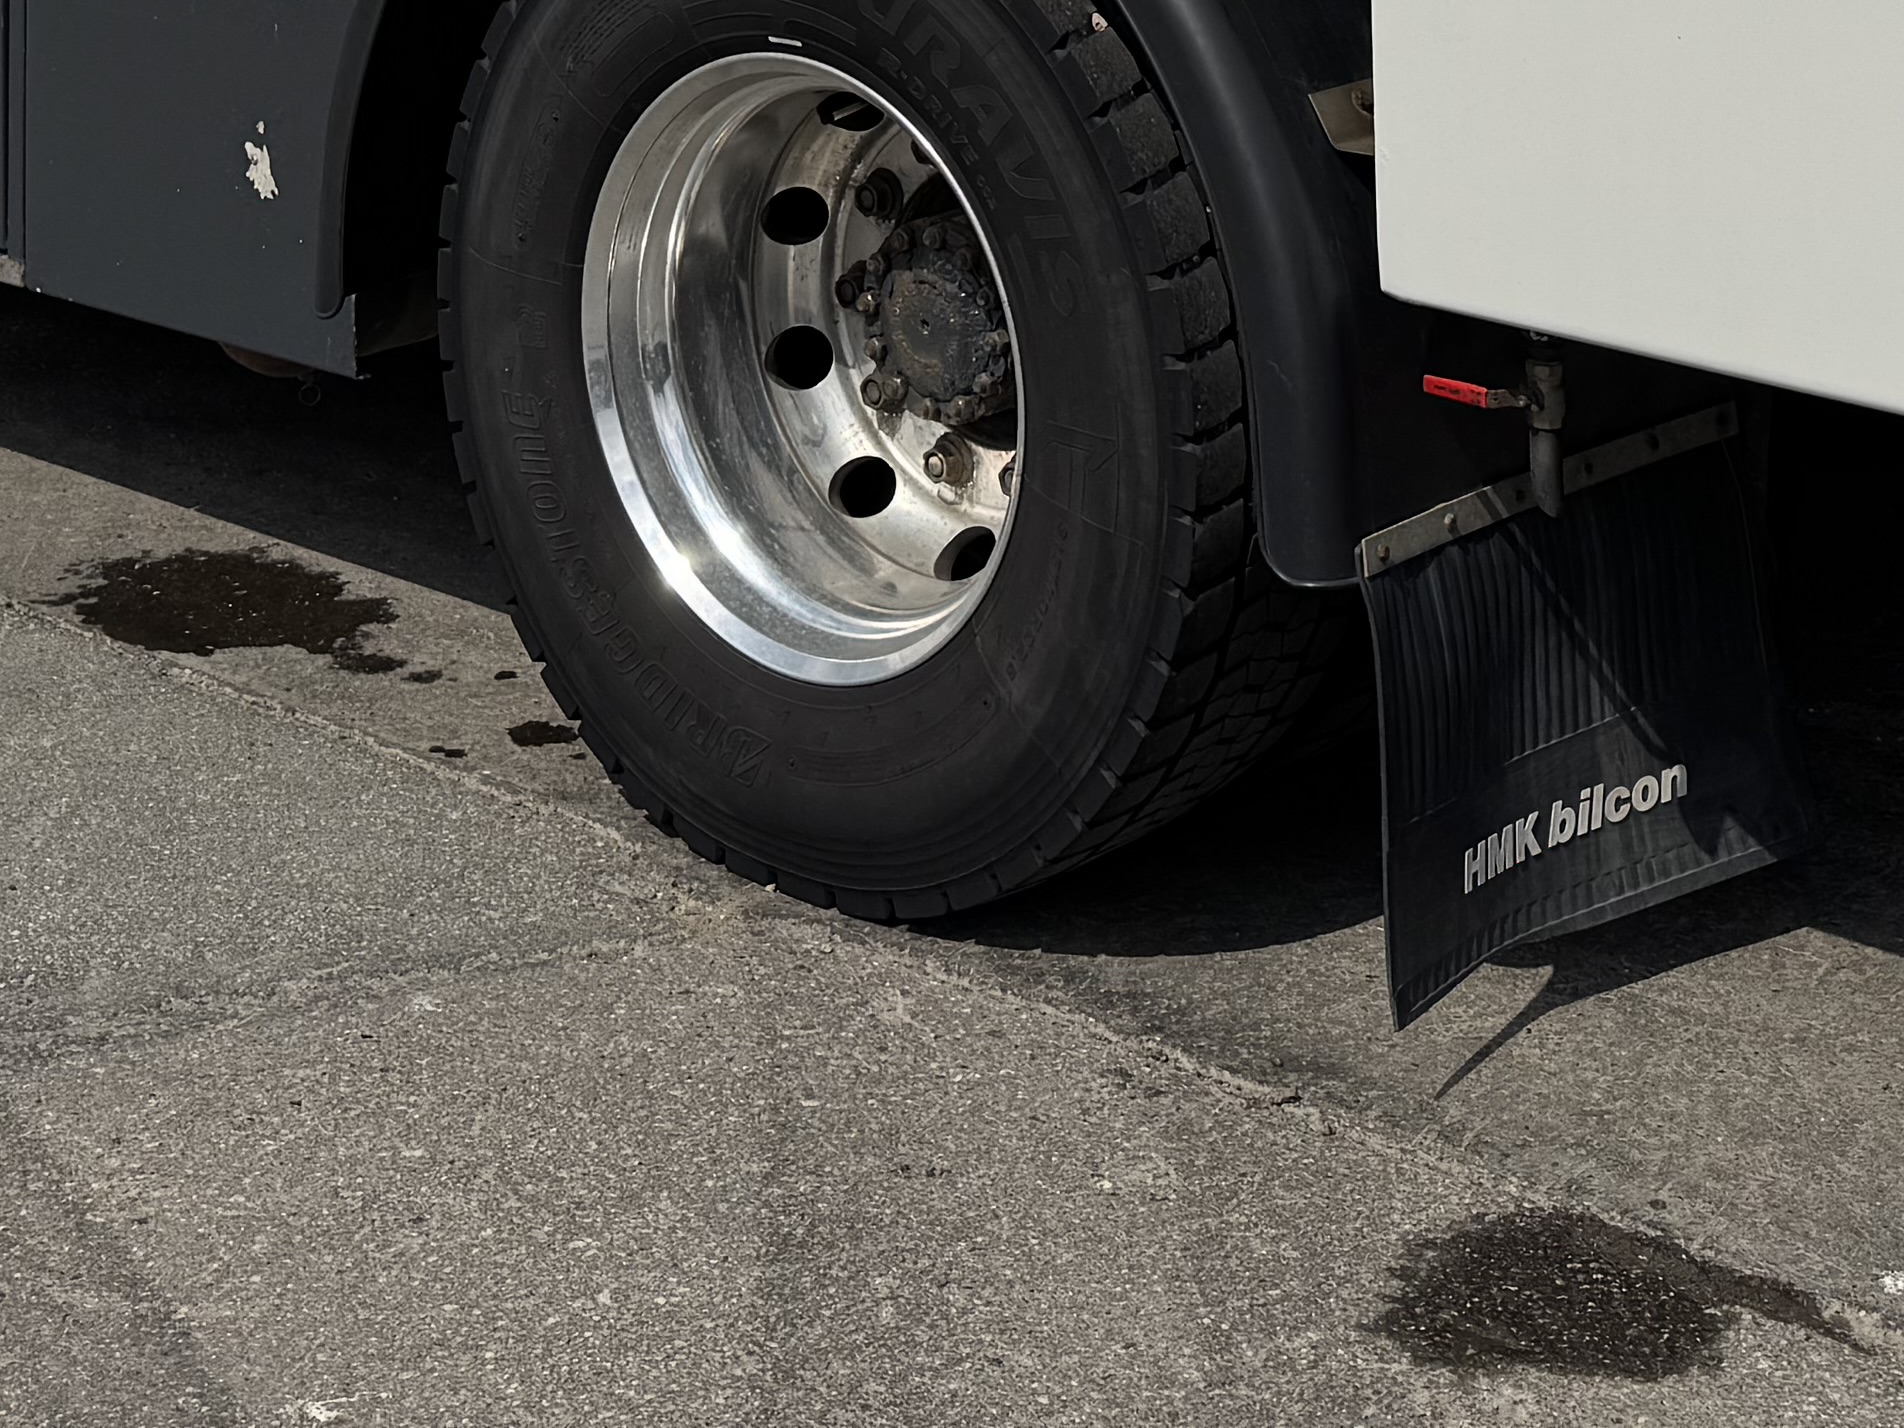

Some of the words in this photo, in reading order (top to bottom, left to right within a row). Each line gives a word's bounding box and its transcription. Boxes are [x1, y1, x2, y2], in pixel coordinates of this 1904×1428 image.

[500, 384, 773, 787] BRIDGESTONE
[1463, 810, 1542, 895] HMK
[1547, 763, 1688, 849] bilcon
